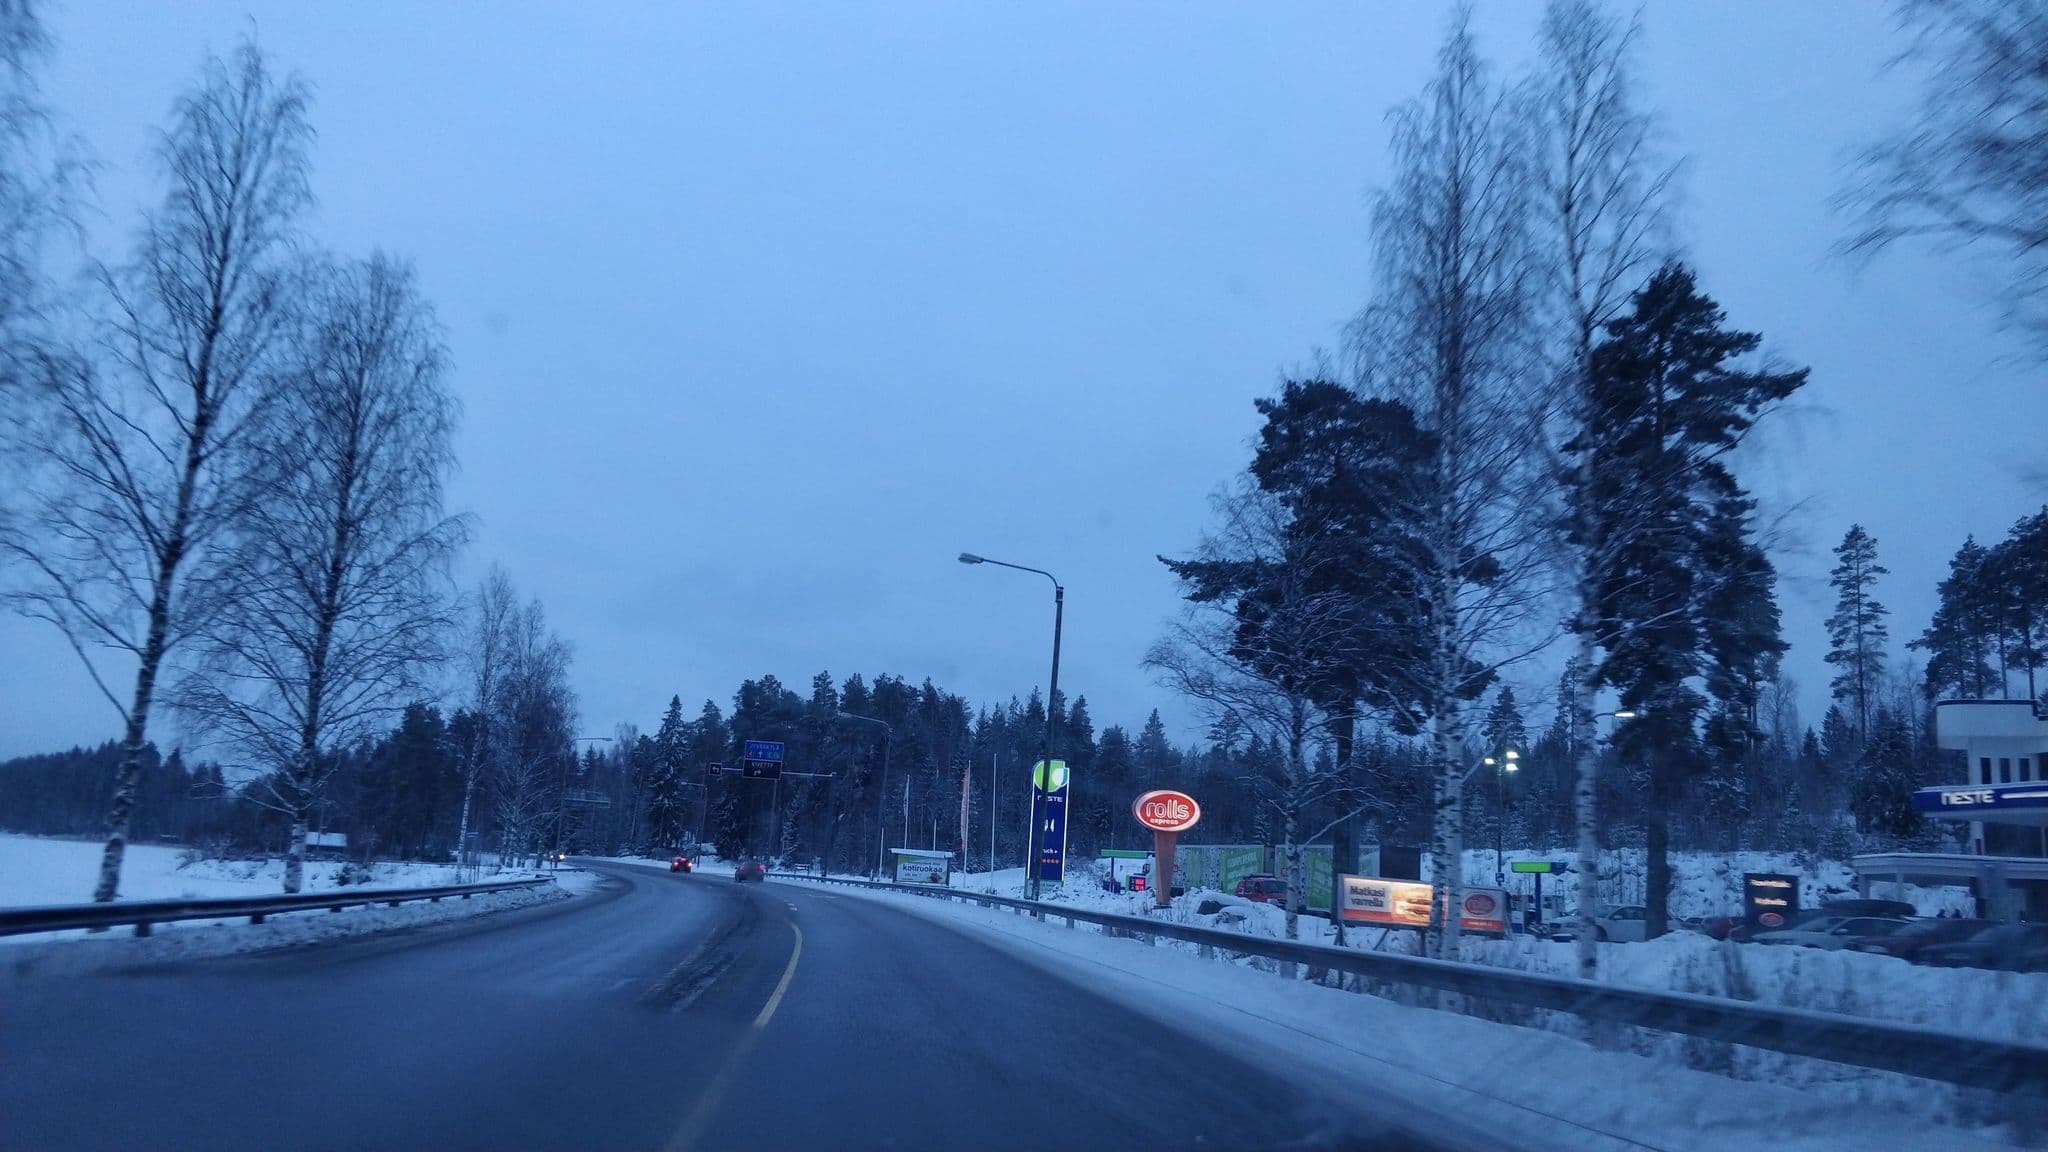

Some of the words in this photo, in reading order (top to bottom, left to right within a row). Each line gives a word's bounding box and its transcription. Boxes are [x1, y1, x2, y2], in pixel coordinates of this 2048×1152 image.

[1941, 790, 1995, 805] NESTE
[1146, 799, 1190, 820] rolls
[1350, 885, 1386, 898] Matkasi
[1351, 897, 1384, 908] varrella
